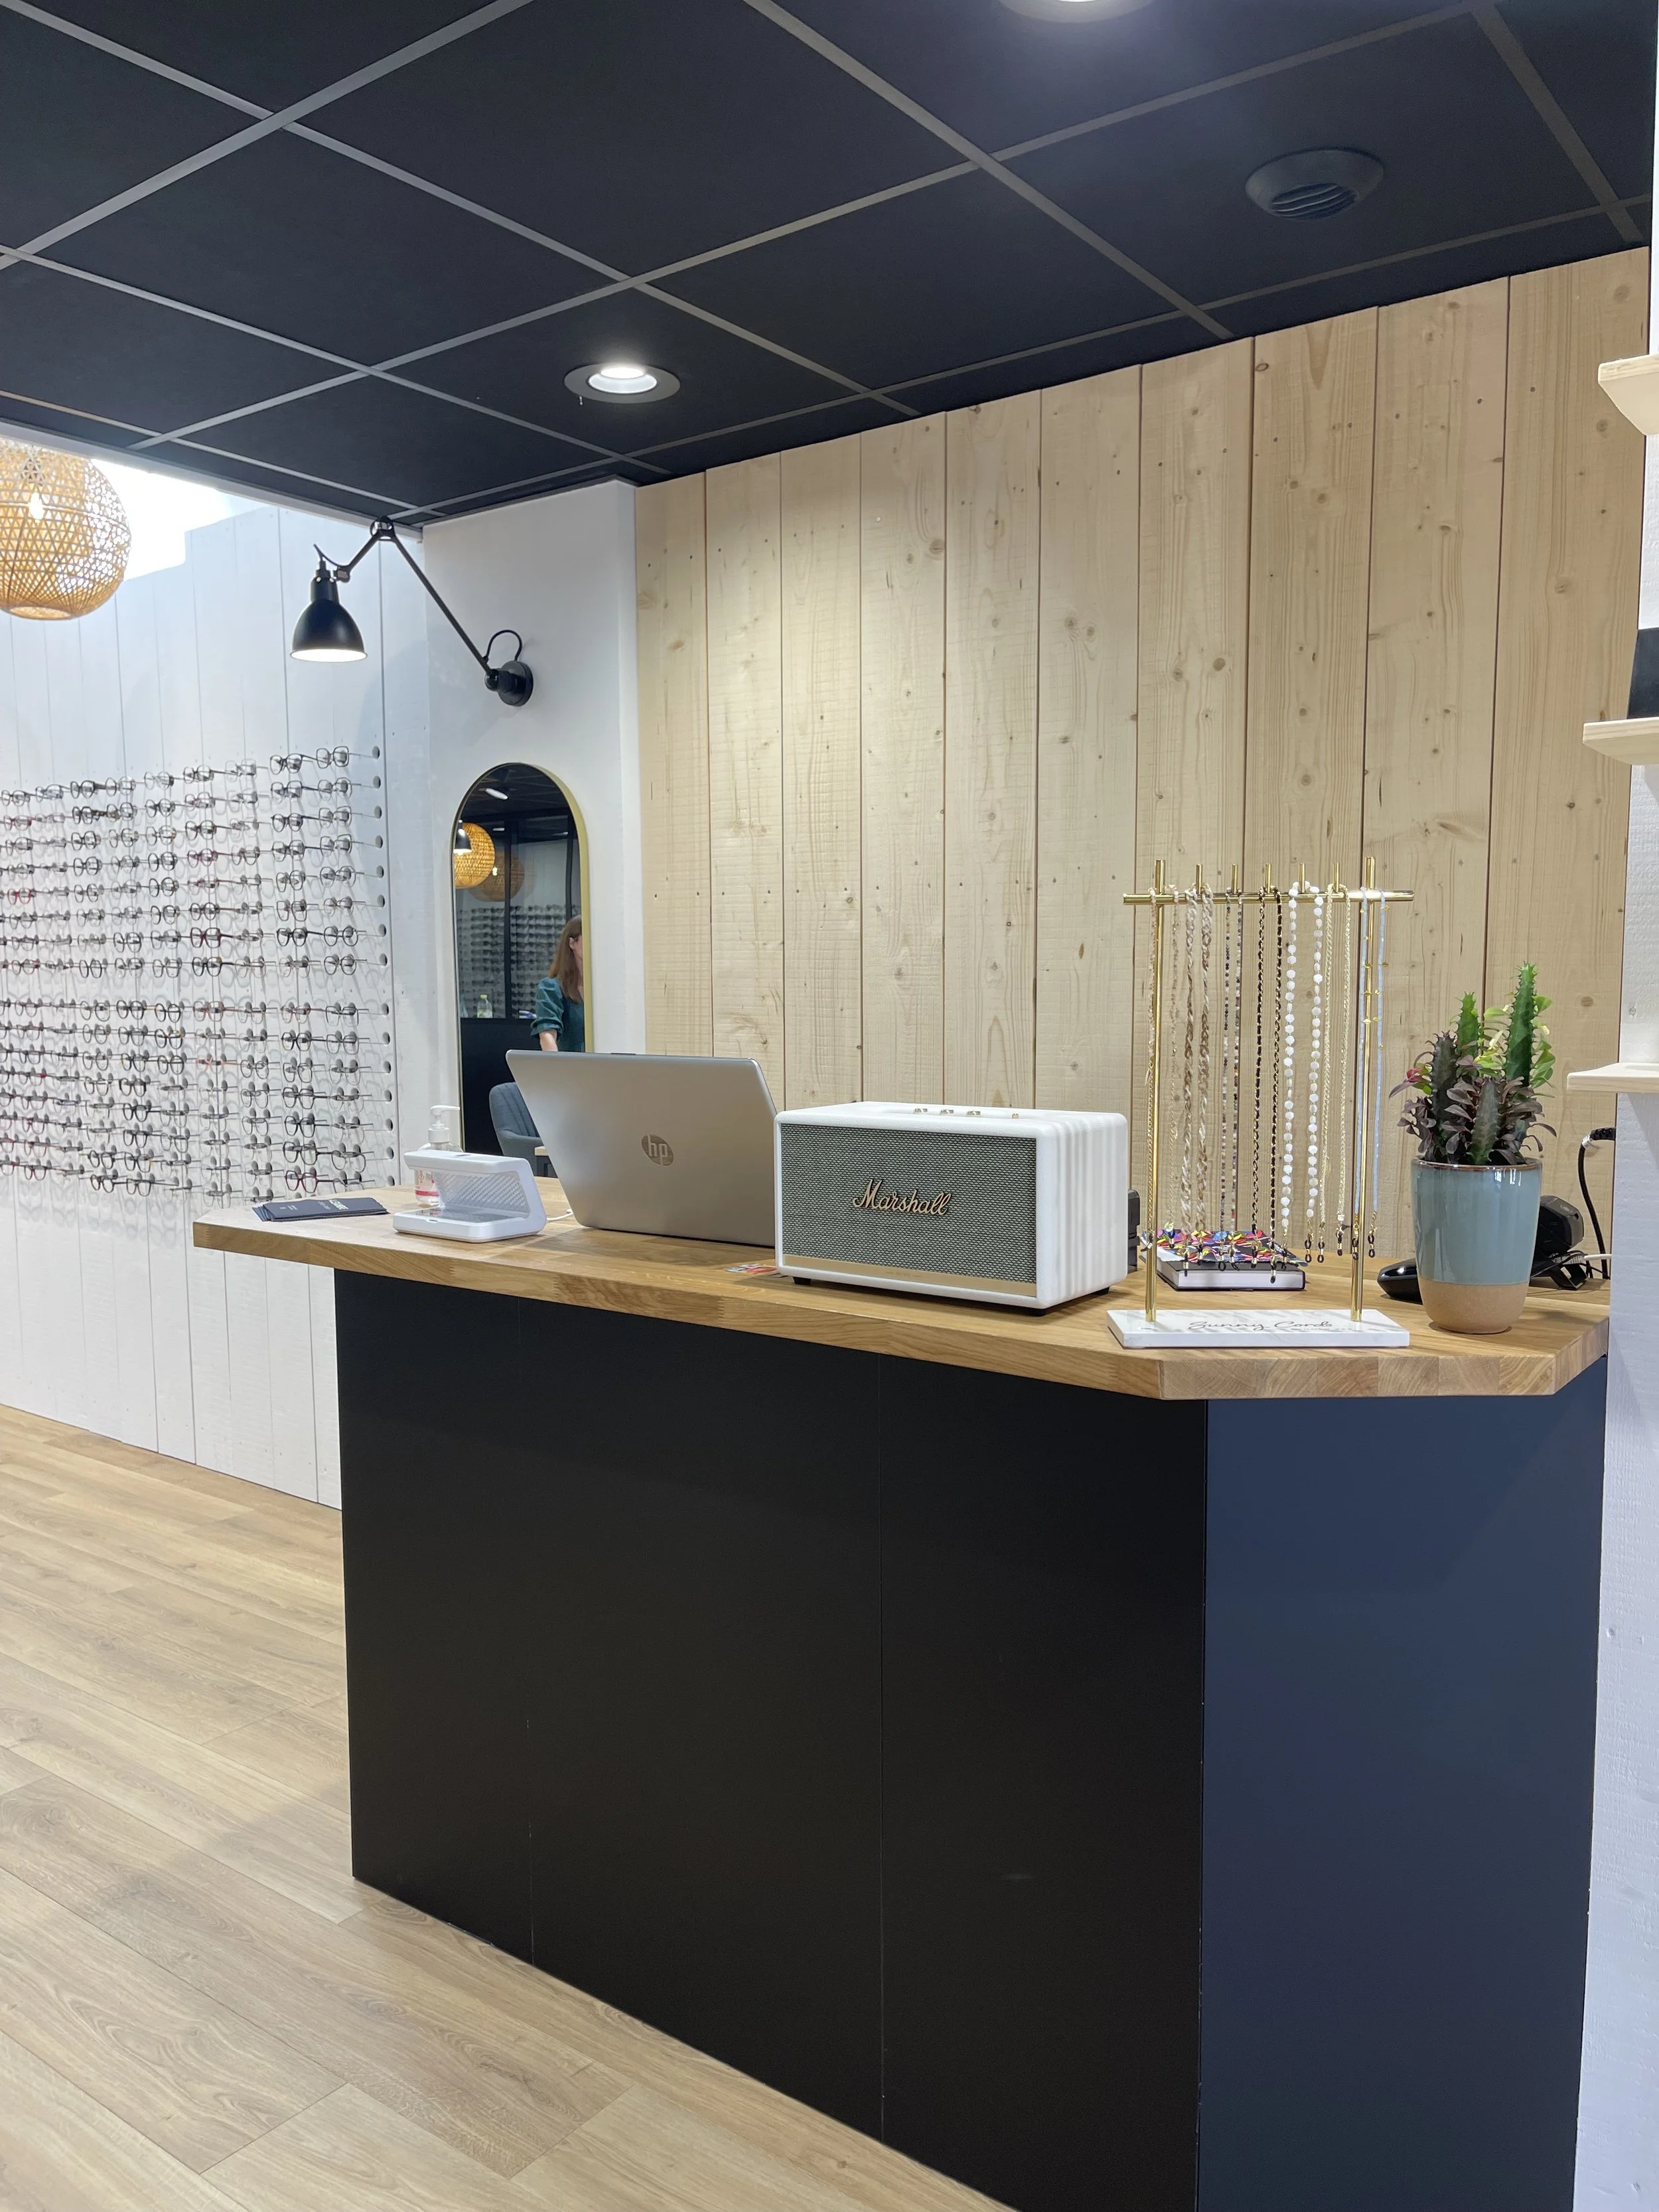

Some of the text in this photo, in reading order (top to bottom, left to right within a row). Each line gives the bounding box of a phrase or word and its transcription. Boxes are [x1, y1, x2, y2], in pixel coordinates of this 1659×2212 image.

[646, 1134, 670, 1166] hp
[852, 1178, 952, 1216] Marshall
[1188, 1321, 1266, 1331] Sunny
